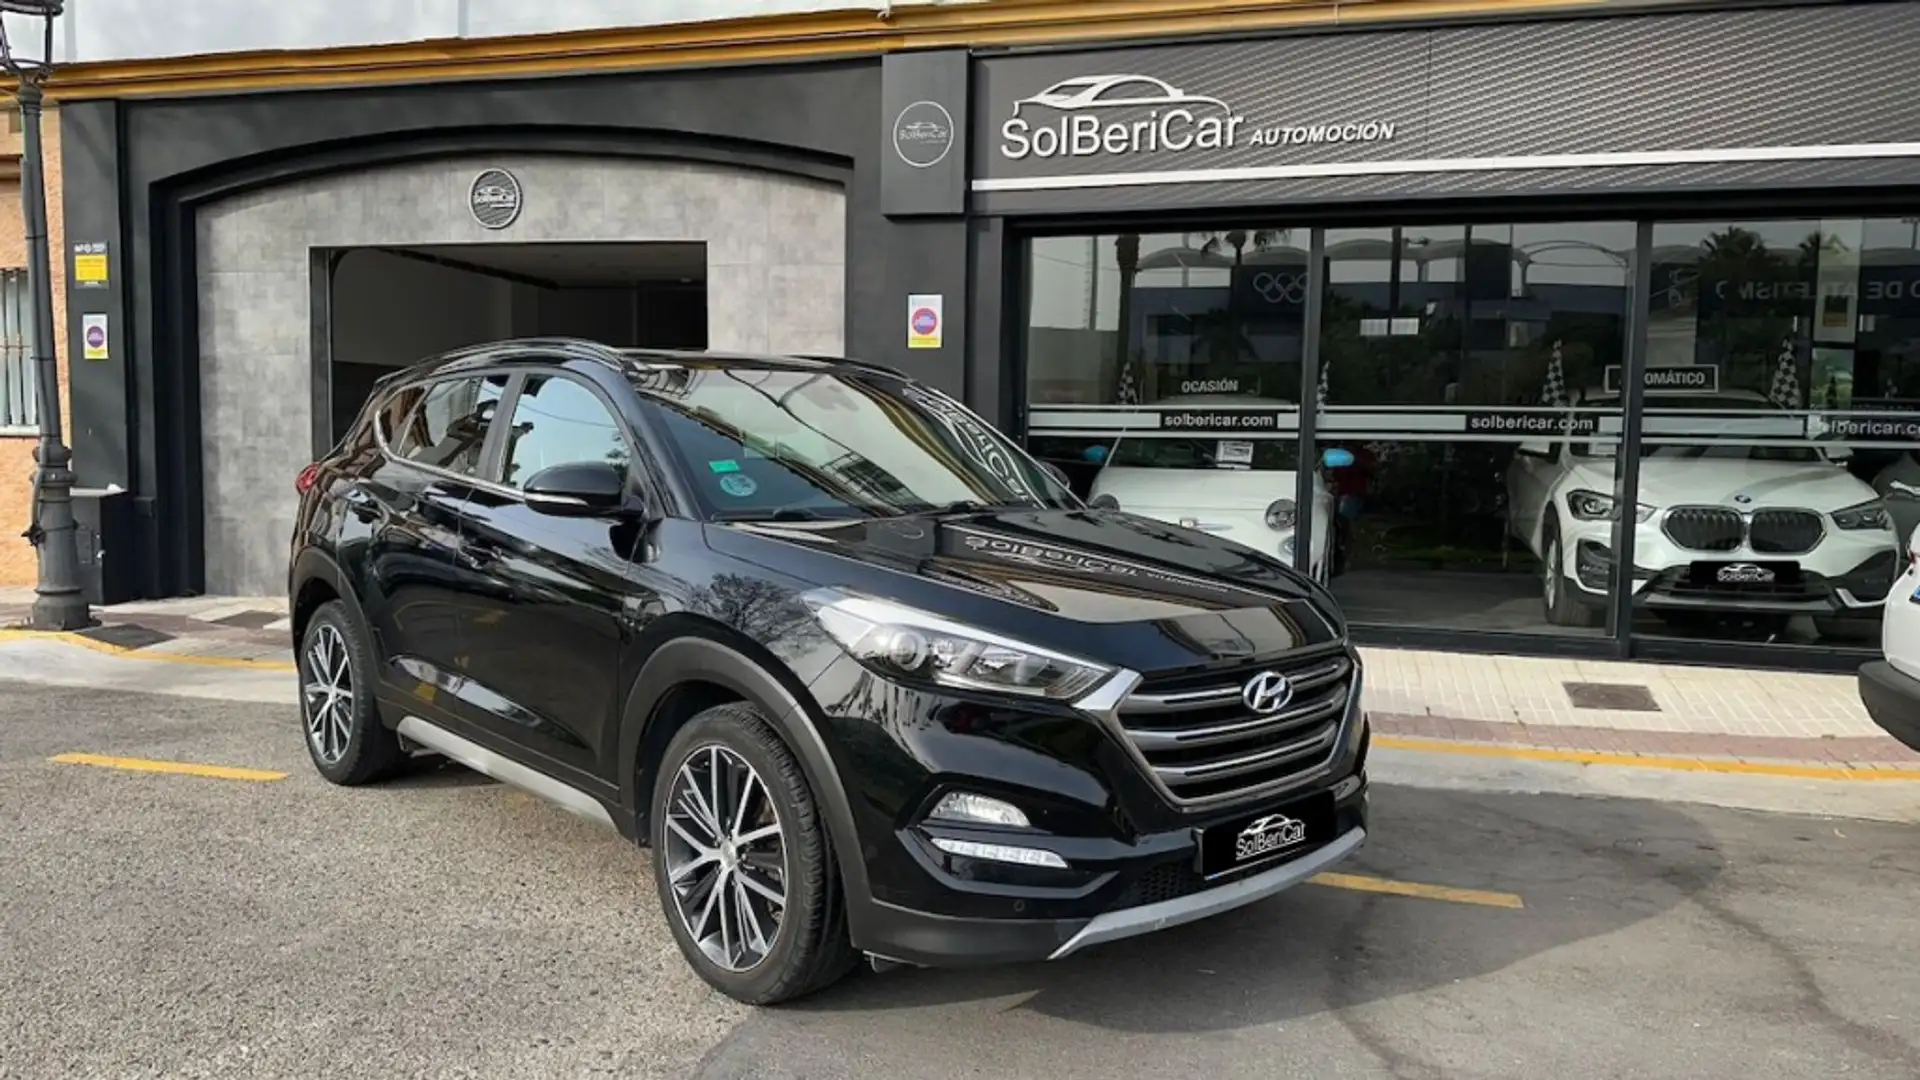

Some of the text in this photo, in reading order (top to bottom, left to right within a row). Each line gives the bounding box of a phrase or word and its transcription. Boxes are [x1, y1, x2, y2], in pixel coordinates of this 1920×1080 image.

[1001, 108, 1396, 160] SolBeriCar AUTOMOCIÓN
[1181, 378, 1239, 393] OCASIÓN
[1644, 369, 1706, 386] OMÁTICO
[1164, 413, 1274, 427] solbericar.com
[1471, 414, 1594, 430] solbericar.com
